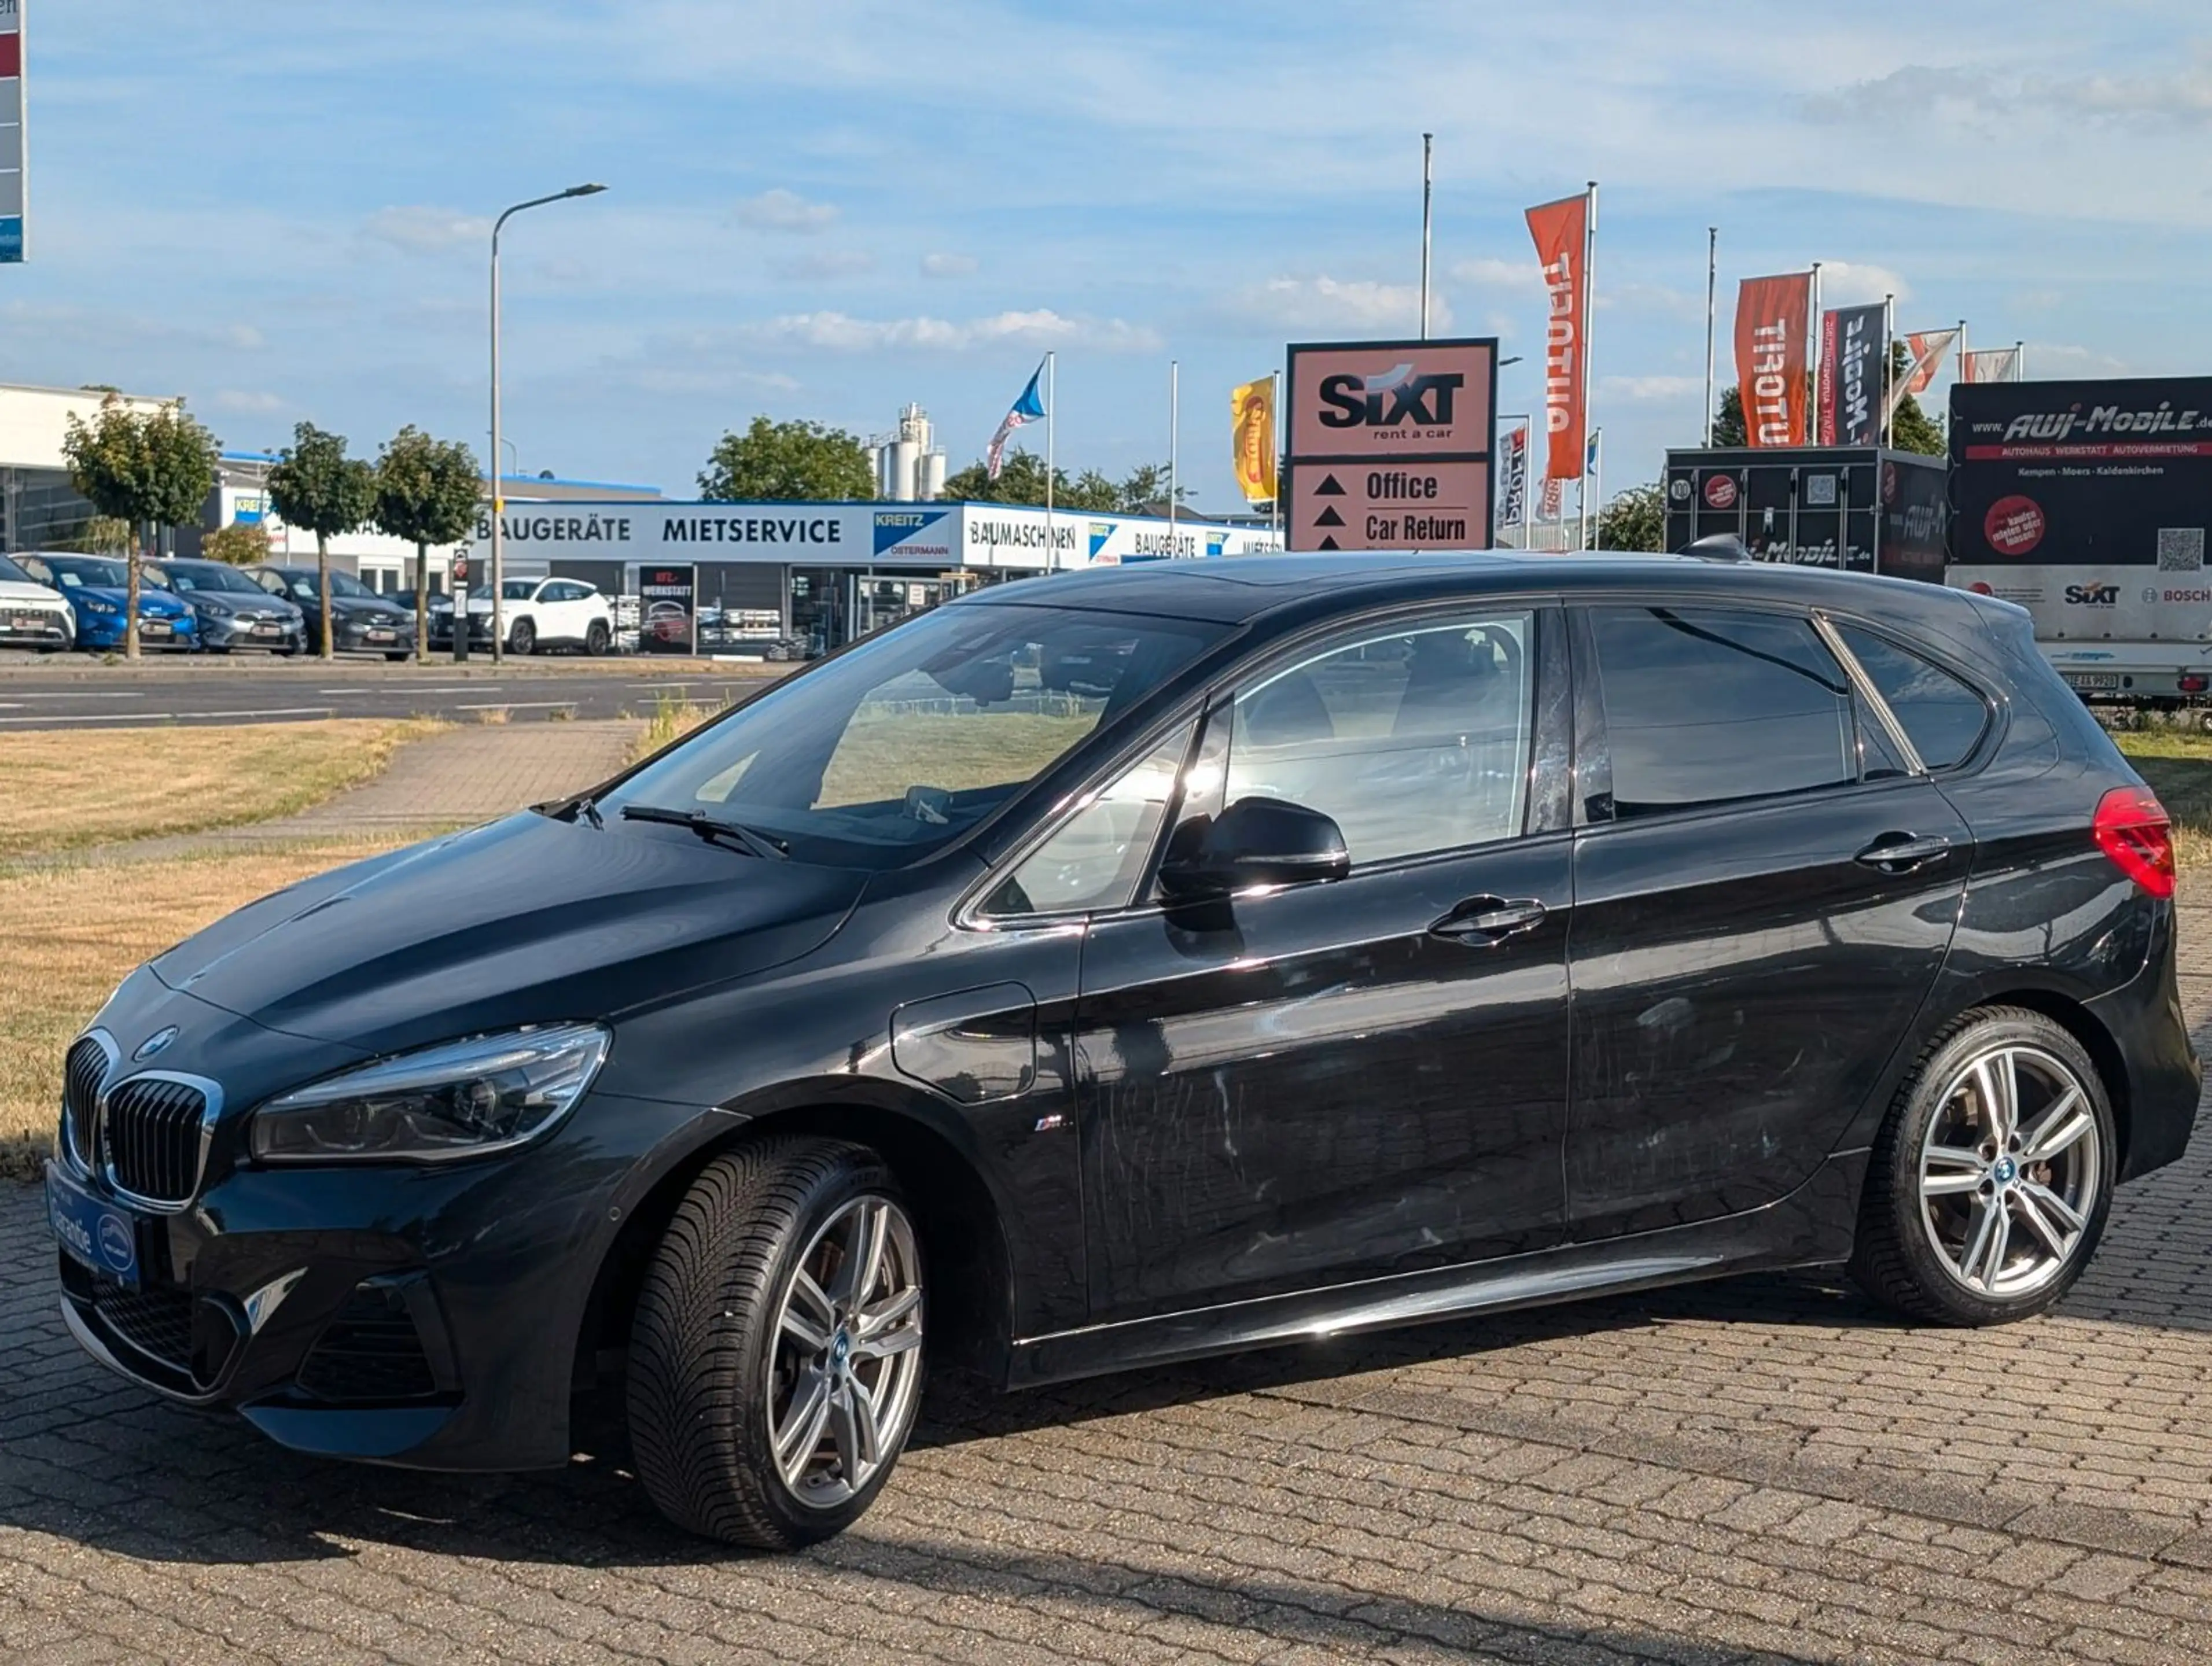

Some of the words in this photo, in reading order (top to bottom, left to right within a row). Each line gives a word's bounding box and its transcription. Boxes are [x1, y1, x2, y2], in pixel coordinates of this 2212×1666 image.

[1319, 363, 1464, 428] SIXT
[1374, 429, 1407, 439] rent
[1412, 430, 1421, 438] a
[1426, 429, 1453, 438] car
[2002, 446, 2051, 456] AUTOHAUS
[2056, 445, 2107, 455] WERKSTATT
[2113, 444, 2198, 455] AUTOVERMIETUNG
[2018, 468, 2056, 478] Kempen
[2062, 467, 2090, 476] Moers
[2097, 465, 2164, 476] Kaldenkirchen
[1367, 472, 1437, 499] Office
[477, 512, 630, 540] BAUGERÄTE
[663, 519, 841, 543] MIETSERVICE
[875, 514, 925, 526] KREITZ
[1366, 515, 1398, 540] Car
[1404, 515, 1466, 540] Return
[970, 520, 1076, 549] BAUMASCHNEN
[1136, 532, 1195, 557] BAUGERÄTE
[891, 545, 949, 555] OSTERMANN
[2065, 583, 2121, 605] SIXT
[2164, 589, 2211, 602] BOSCH
